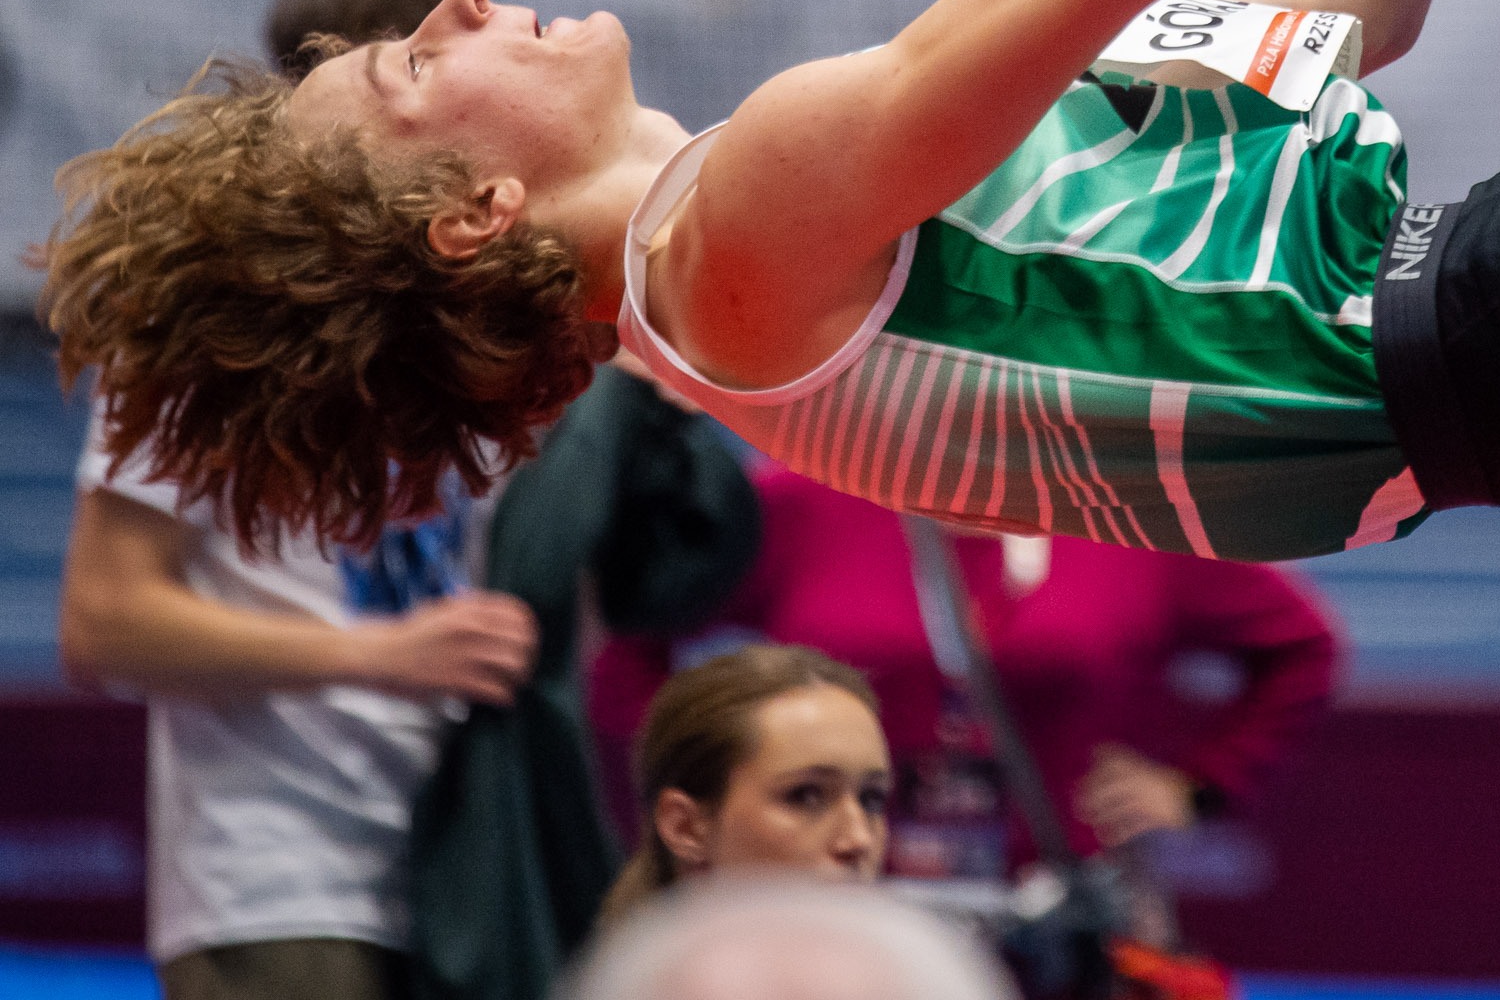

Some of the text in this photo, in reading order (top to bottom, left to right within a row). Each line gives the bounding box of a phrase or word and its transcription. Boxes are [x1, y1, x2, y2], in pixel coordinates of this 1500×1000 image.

[1303, 13, 1339, 55] RZES
[1256, 46, 1281, 77] PZLA
[1385, 203, 1445, 281] NIKE
